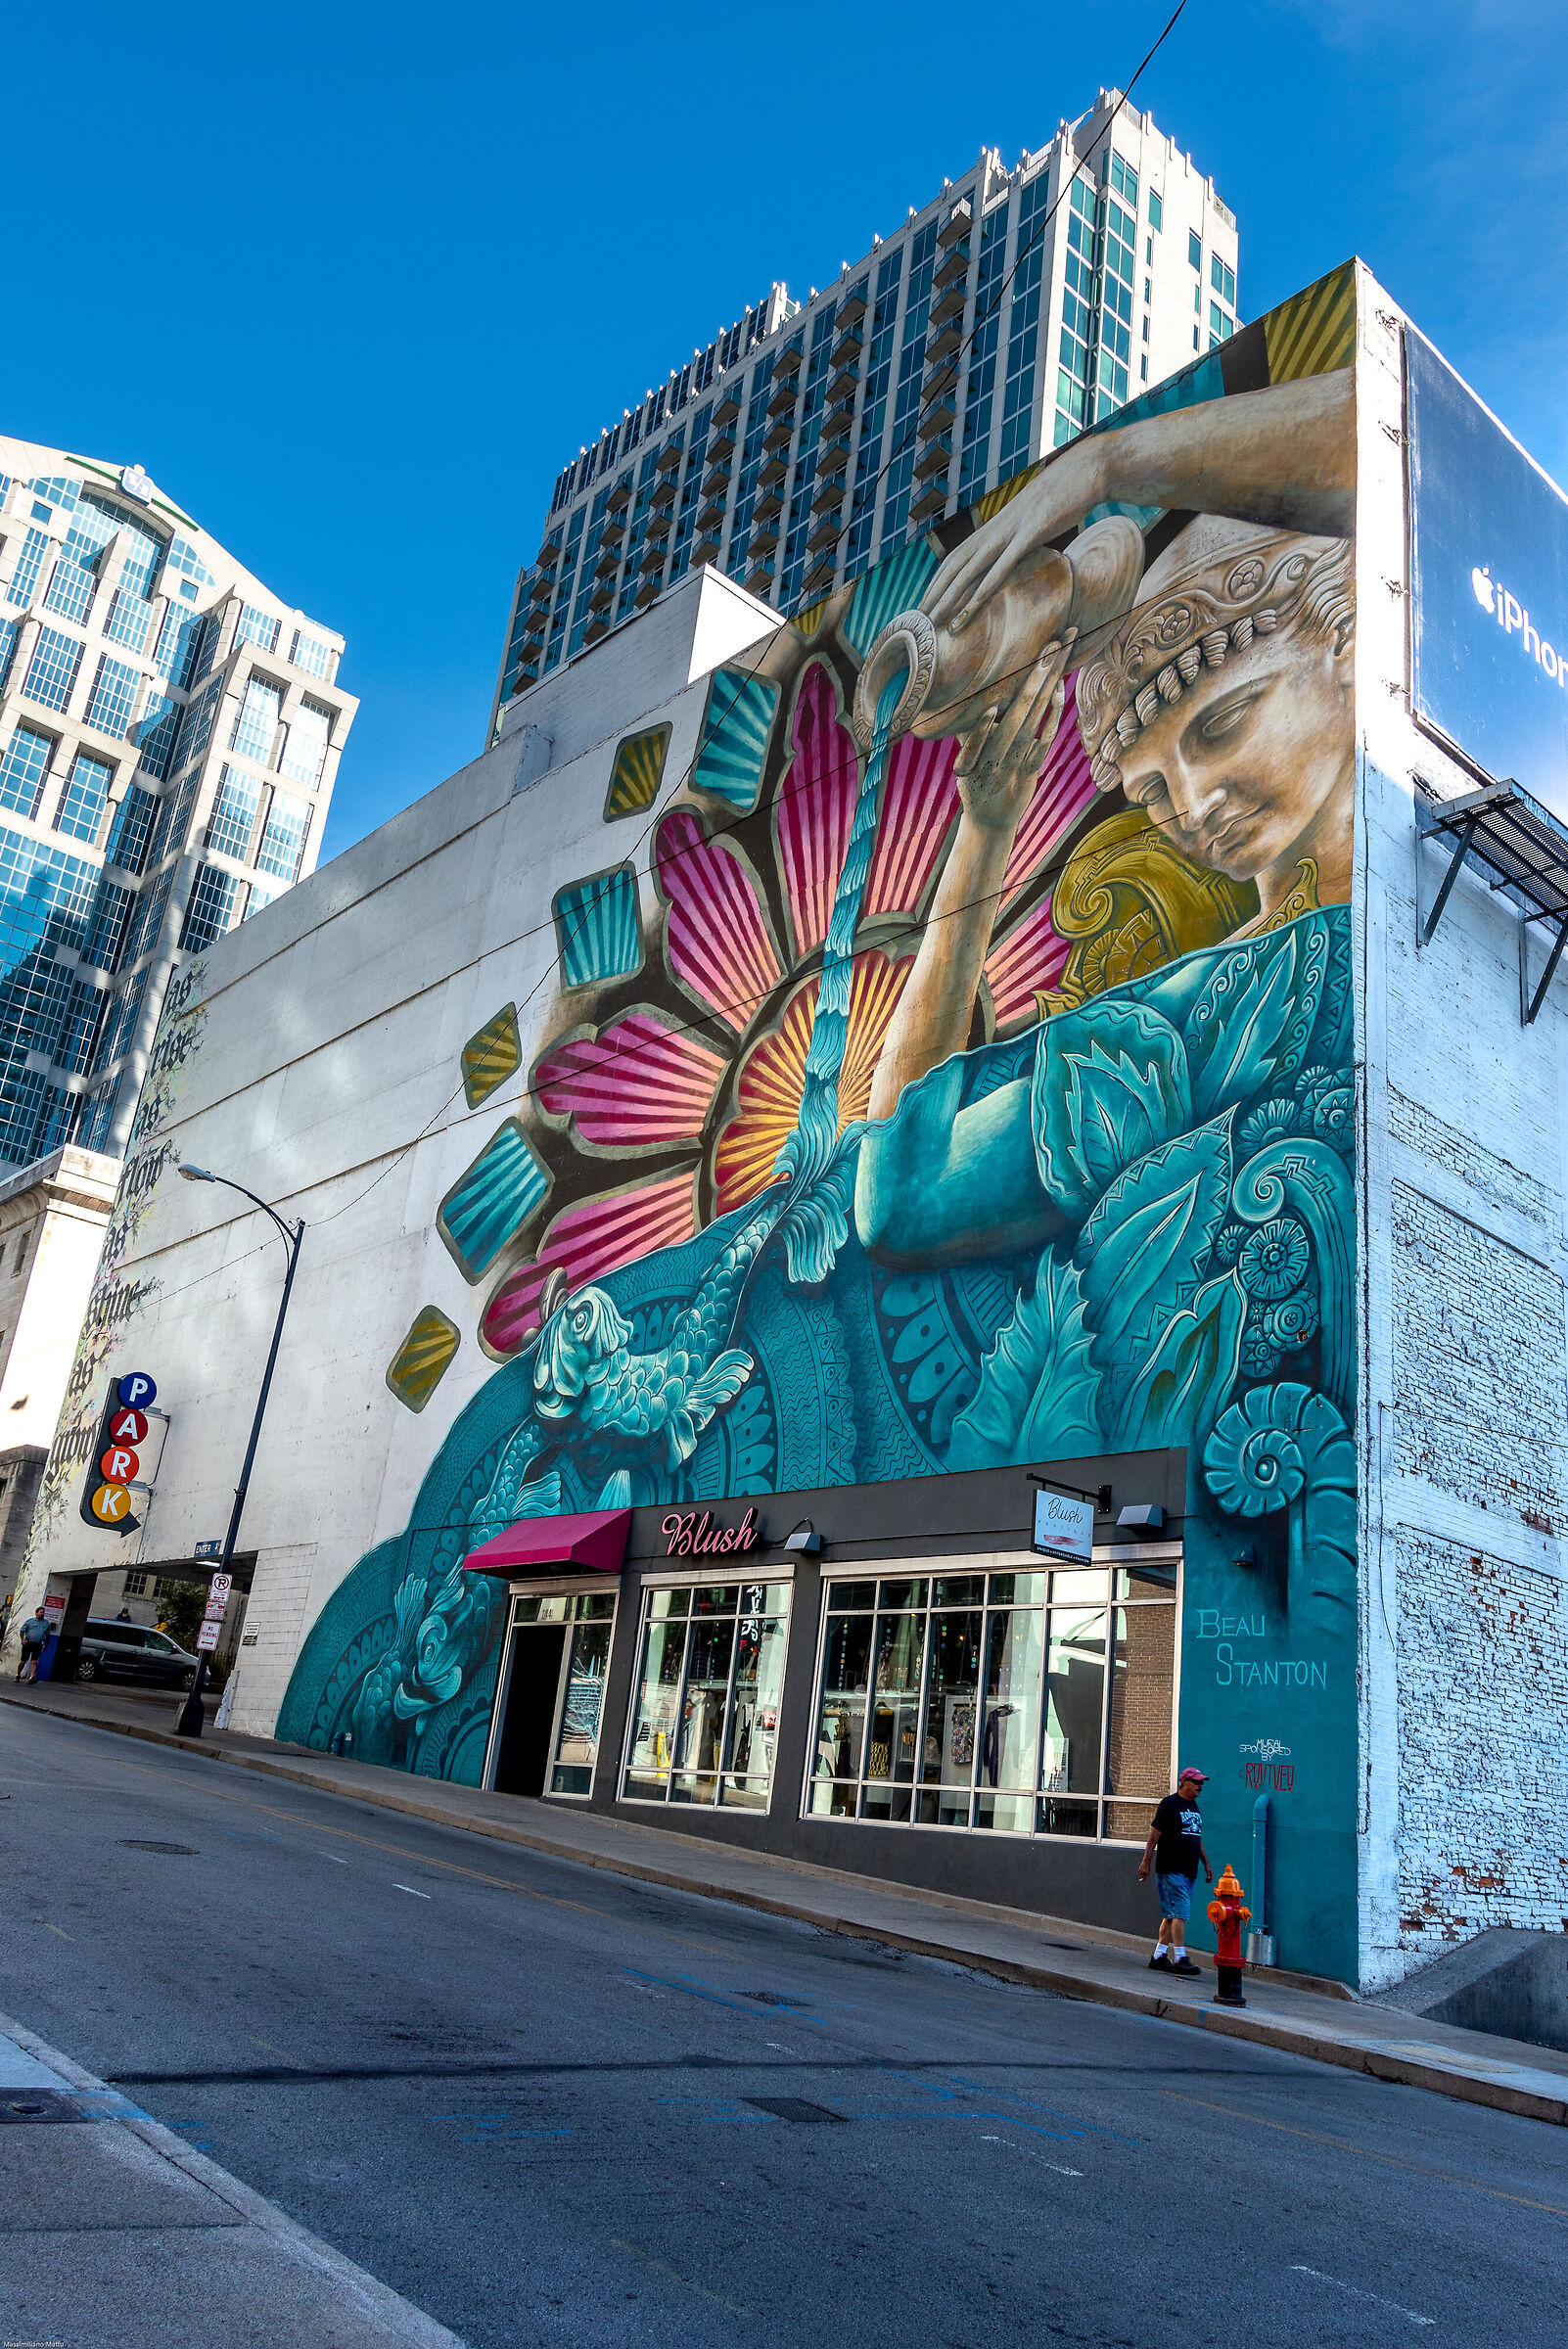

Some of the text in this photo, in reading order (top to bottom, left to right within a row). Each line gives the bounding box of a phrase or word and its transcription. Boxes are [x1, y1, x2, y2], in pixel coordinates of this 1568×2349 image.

[101, 1377, 148, 1516] PARK
[1047, 1497, 1084, 1524] Blush
[662, 1507, 759, 1555] Blush
[196, 1543, 211, 1554] ENTER
[1196, 1609, 1266, 1638] BEAU
[1216, 1642, 1327, 1690] STANTON
[1238, 1744, 1292, 1756] SPONSORED
[1261, 1752, 1275, 1762] BY
